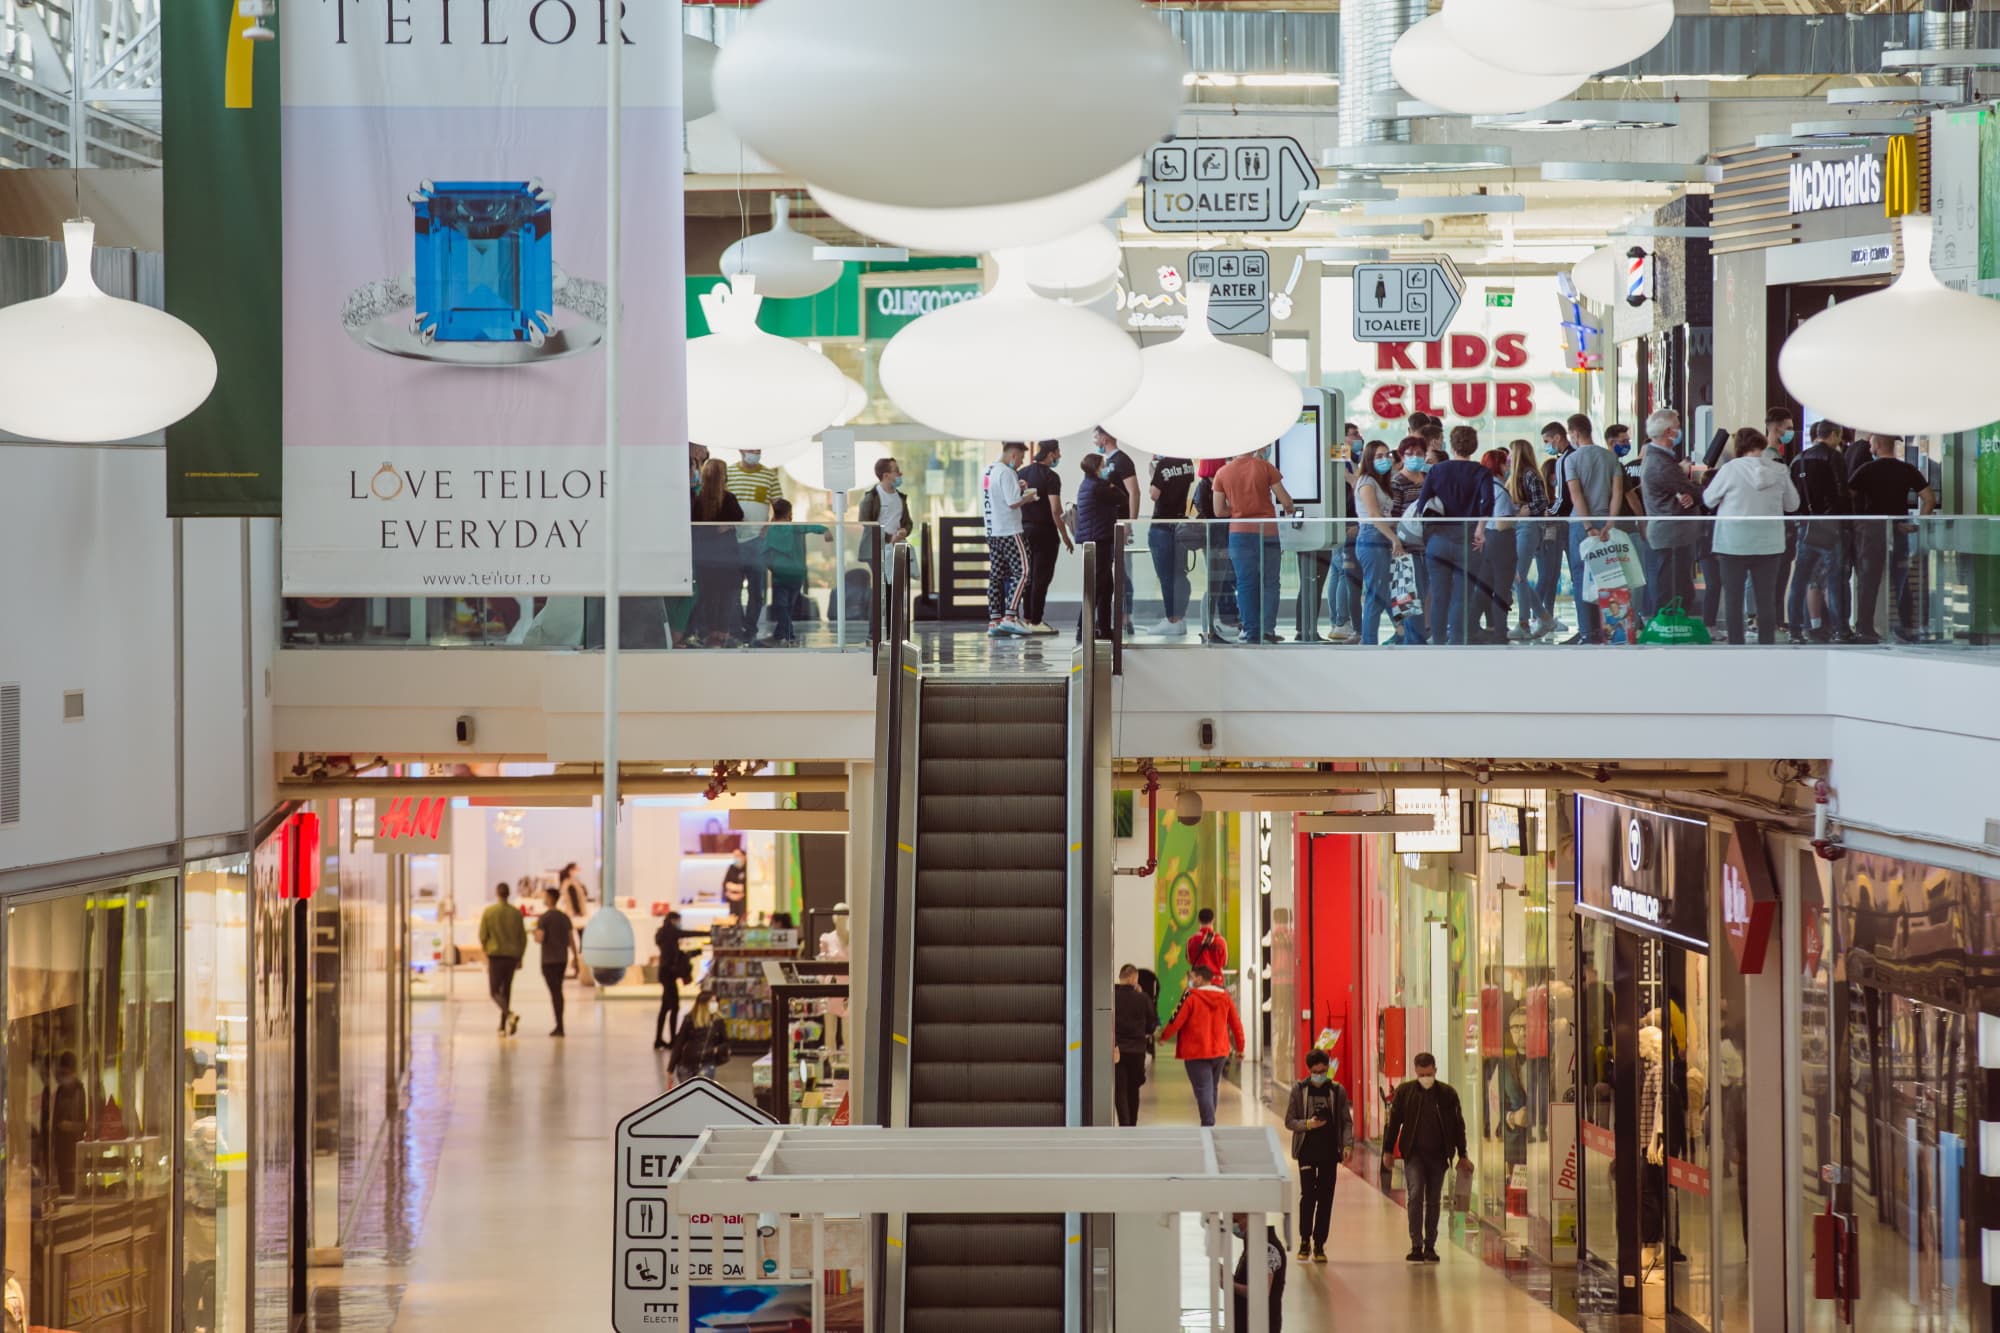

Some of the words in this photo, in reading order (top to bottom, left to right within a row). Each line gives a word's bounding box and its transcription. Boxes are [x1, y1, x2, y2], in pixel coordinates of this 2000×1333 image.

[322, 0, 637, 45] TEILOR
[1788, 153, 1881, 213] McDonald's
[1163, 193, 1259, 212] TOALETE
[1210, 283, 1257, 297] ARTER
[1364, 319, 1421, 331] TOALETE
[1375, 332, 1529, 371] KIDS
[1371, 381, 1534, 420] CLUB
[381, 519, 589, 549] EVERYDAY
[422, 571, 551, 585] www.teilor.ro
[379, 796, 447, 839] H&M
